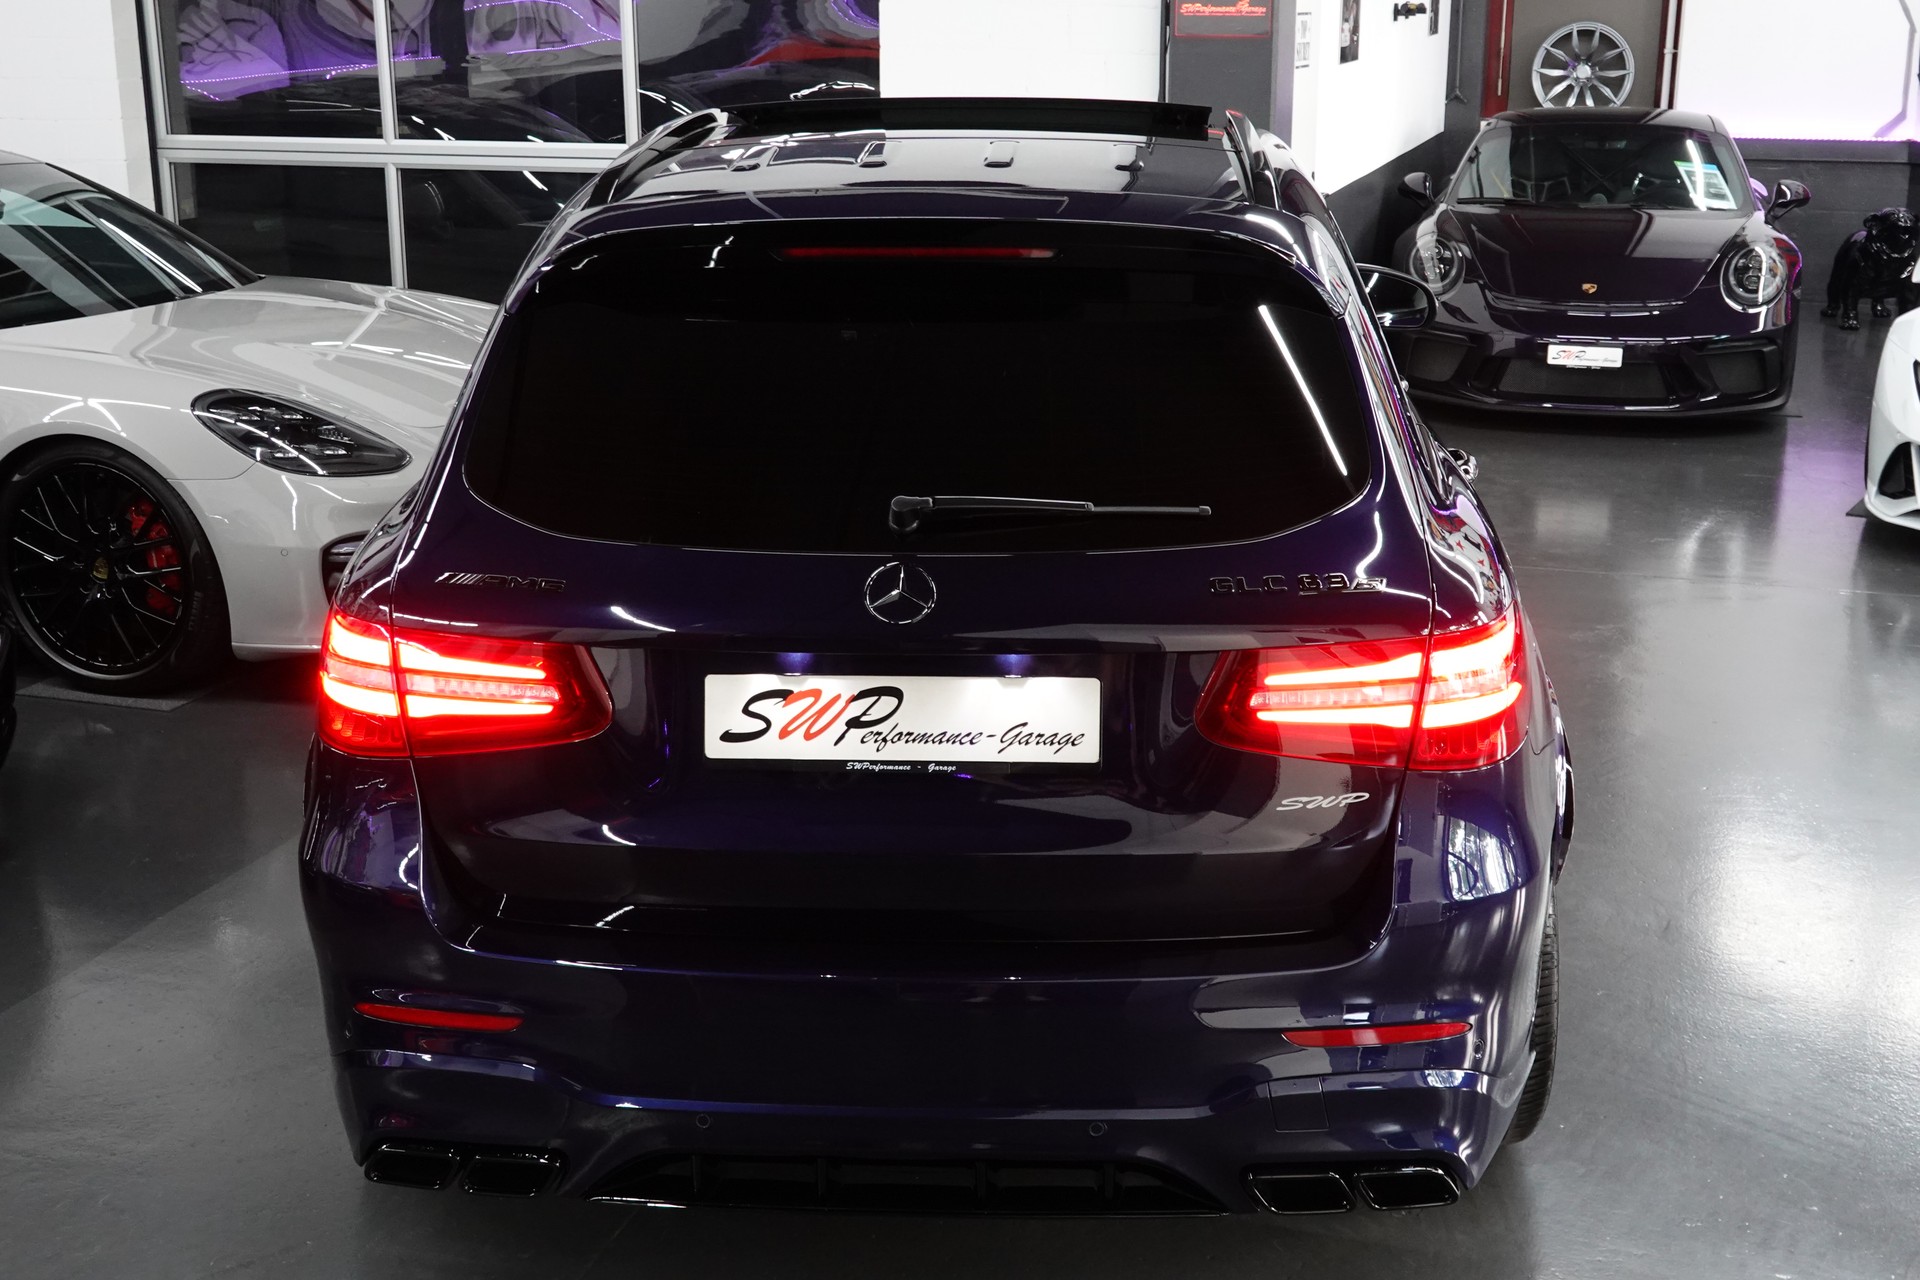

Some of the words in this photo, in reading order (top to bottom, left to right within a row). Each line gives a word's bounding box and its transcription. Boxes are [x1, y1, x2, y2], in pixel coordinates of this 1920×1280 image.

[1209, 575, 1288, 593] GLC
[846, 762, 912, 772] SWPerformance
[927, 763, 957, 773] Garage
[1276, 792, 1370, 811] SWP
